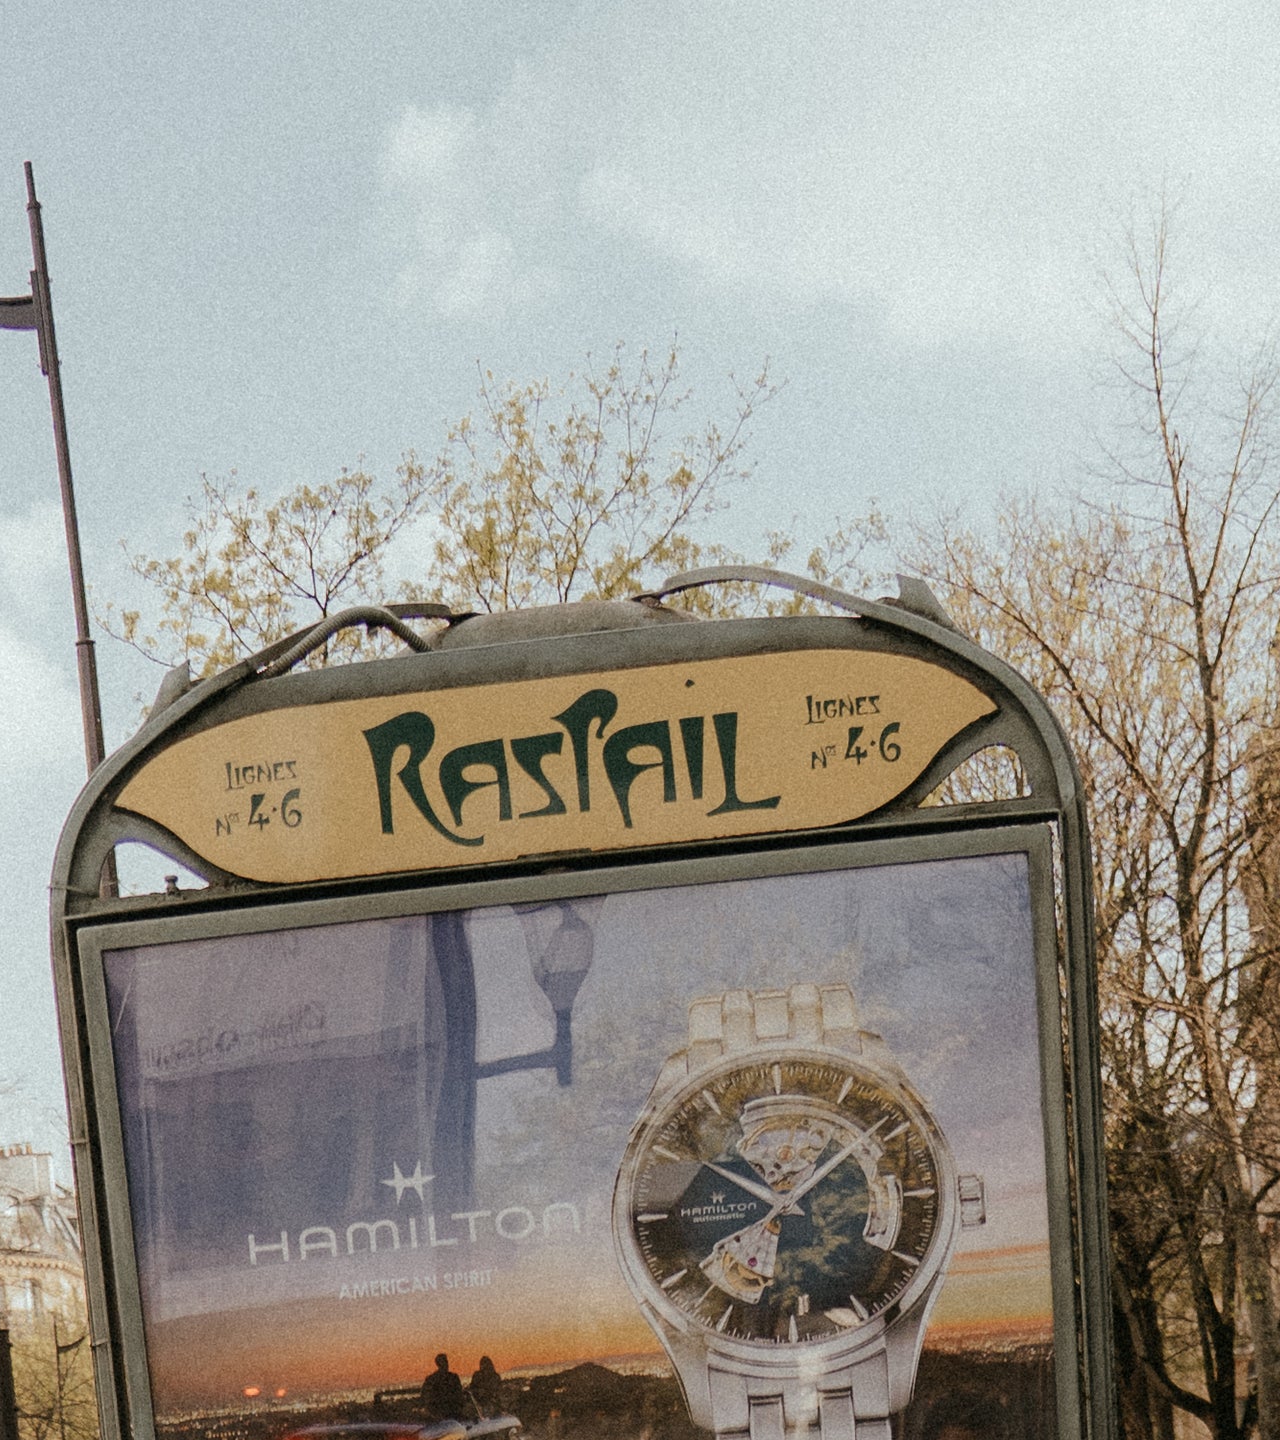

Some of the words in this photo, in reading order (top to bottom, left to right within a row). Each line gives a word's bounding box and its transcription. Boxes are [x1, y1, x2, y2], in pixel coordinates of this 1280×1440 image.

[804, 694, 880, 725] LIGNES
[225, 761, 297, 791] LIGNES
[362, 688, 782, 847] RASPAIL
[680, 1202, 757, 1217] HAMILTON
[693, 1211, 746, 1223] automatic
[248, 1202, 581, 1265] HAMILTON
[338, 1273, 437, 1300] AMERICAN
